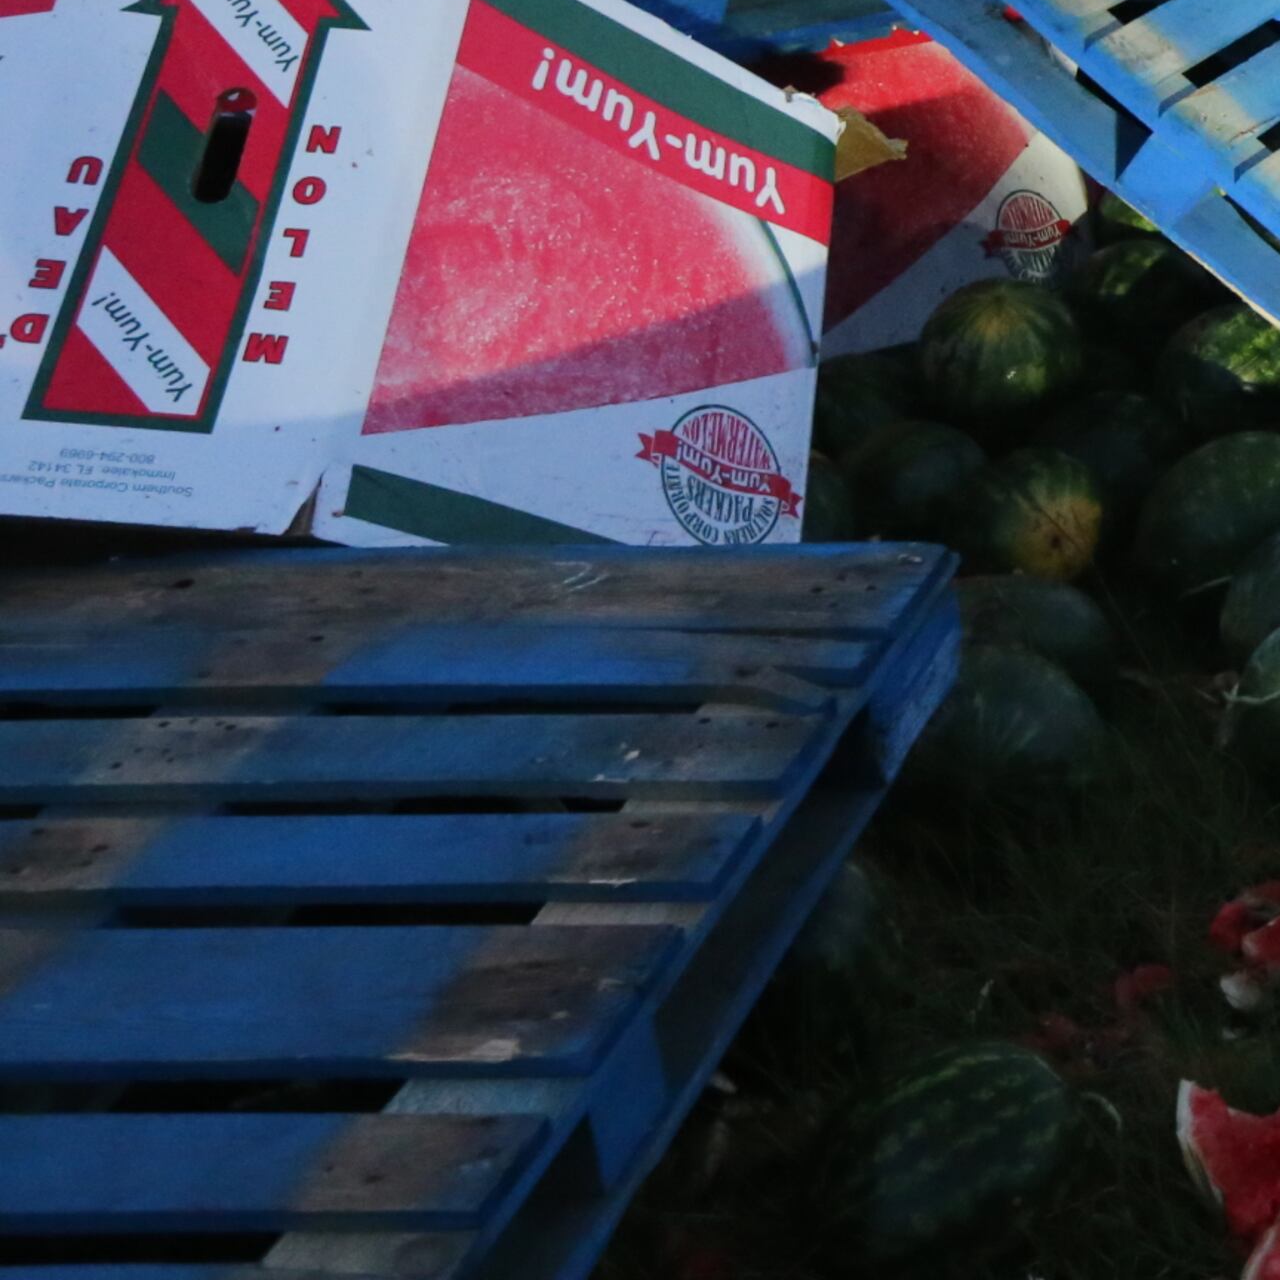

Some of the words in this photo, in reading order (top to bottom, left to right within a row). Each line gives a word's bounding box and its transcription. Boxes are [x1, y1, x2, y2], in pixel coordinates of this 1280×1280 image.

[531, 47, 786, 215] Yum-Yum!
[242, 124, 342, 364] MELON
[91, 290, 193, 403] Yum-Yum!
[676, 440, 772, 494] Yum-Yum!
[682, 411, 773, 471] WATERMELON
[61, 477, 129, 493] Corporate
[666, 463, 719, 543] CORPORATE
[685, 475, 754, 525] PACKERS
[723, 497, 777, 545] SOUTHERN
